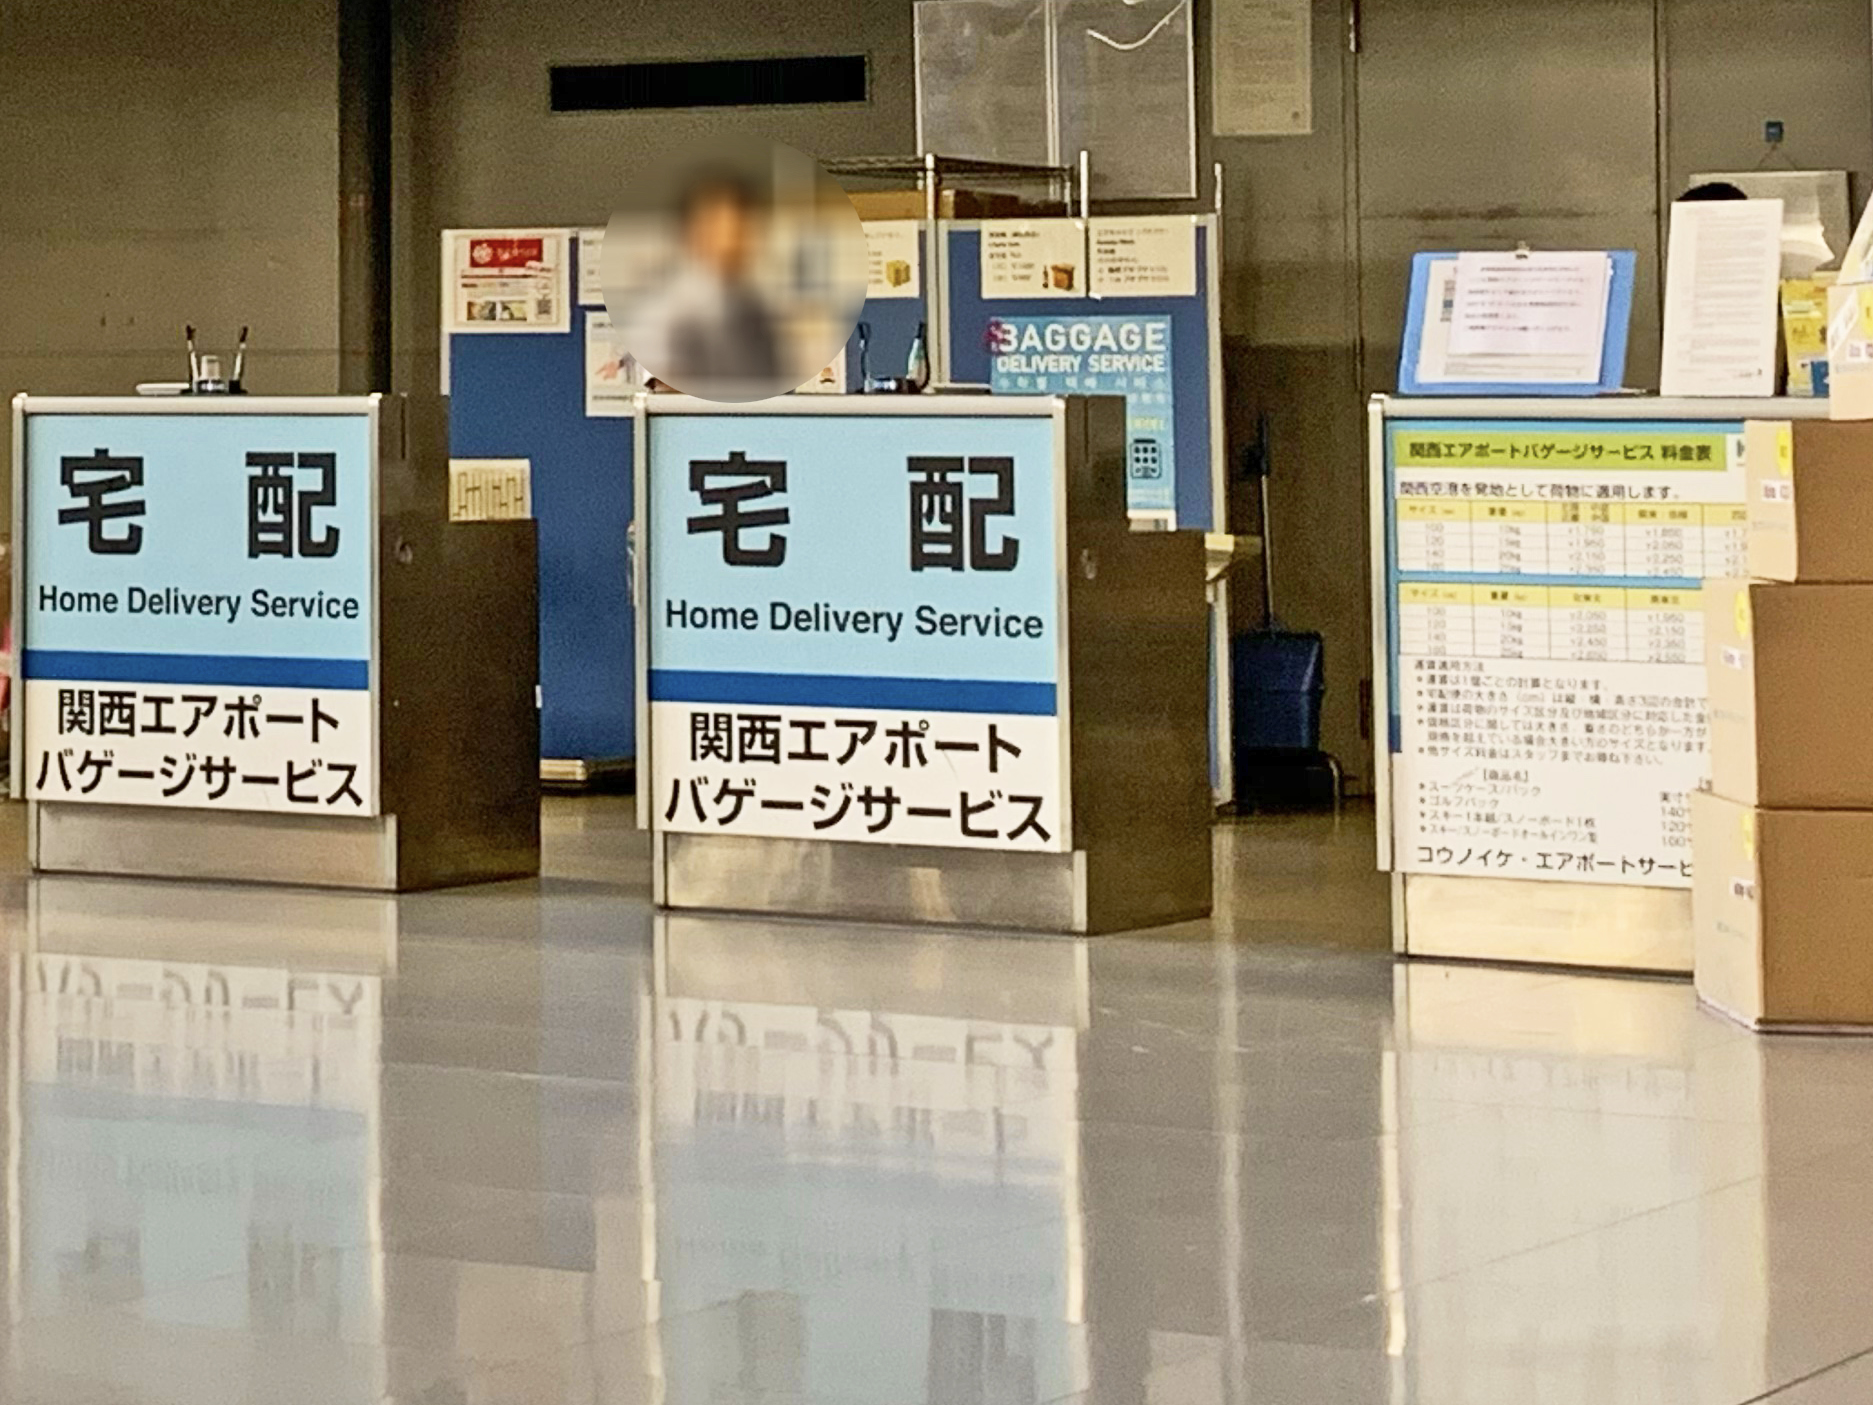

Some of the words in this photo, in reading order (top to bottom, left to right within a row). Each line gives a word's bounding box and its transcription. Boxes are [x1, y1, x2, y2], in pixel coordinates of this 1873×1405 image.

[996, 322, 1167, 353] BAGGAGE
[996, 354, 1082, 373] DELIVERY
[1087, 354, 1166, 373] SERVICE
[1661, 443, 1712, 462] 料金表
[39, 584, 118, 614] Home
[129, 586, 241, 623] Delivery
[251, 589, 359, 620] Service
[666, 600, 759, 631] Home
[770, 601, 903, 642] Delivery
[915, 605, 1043, 638] Service
[58, 688, 340, 744] 関西エアポート
[690, 711, 1021, 774] 関西エアポート
[35, 747, 364, 807] バゲージサービス
[664, 777, 1051, 843] バゲージサービス
